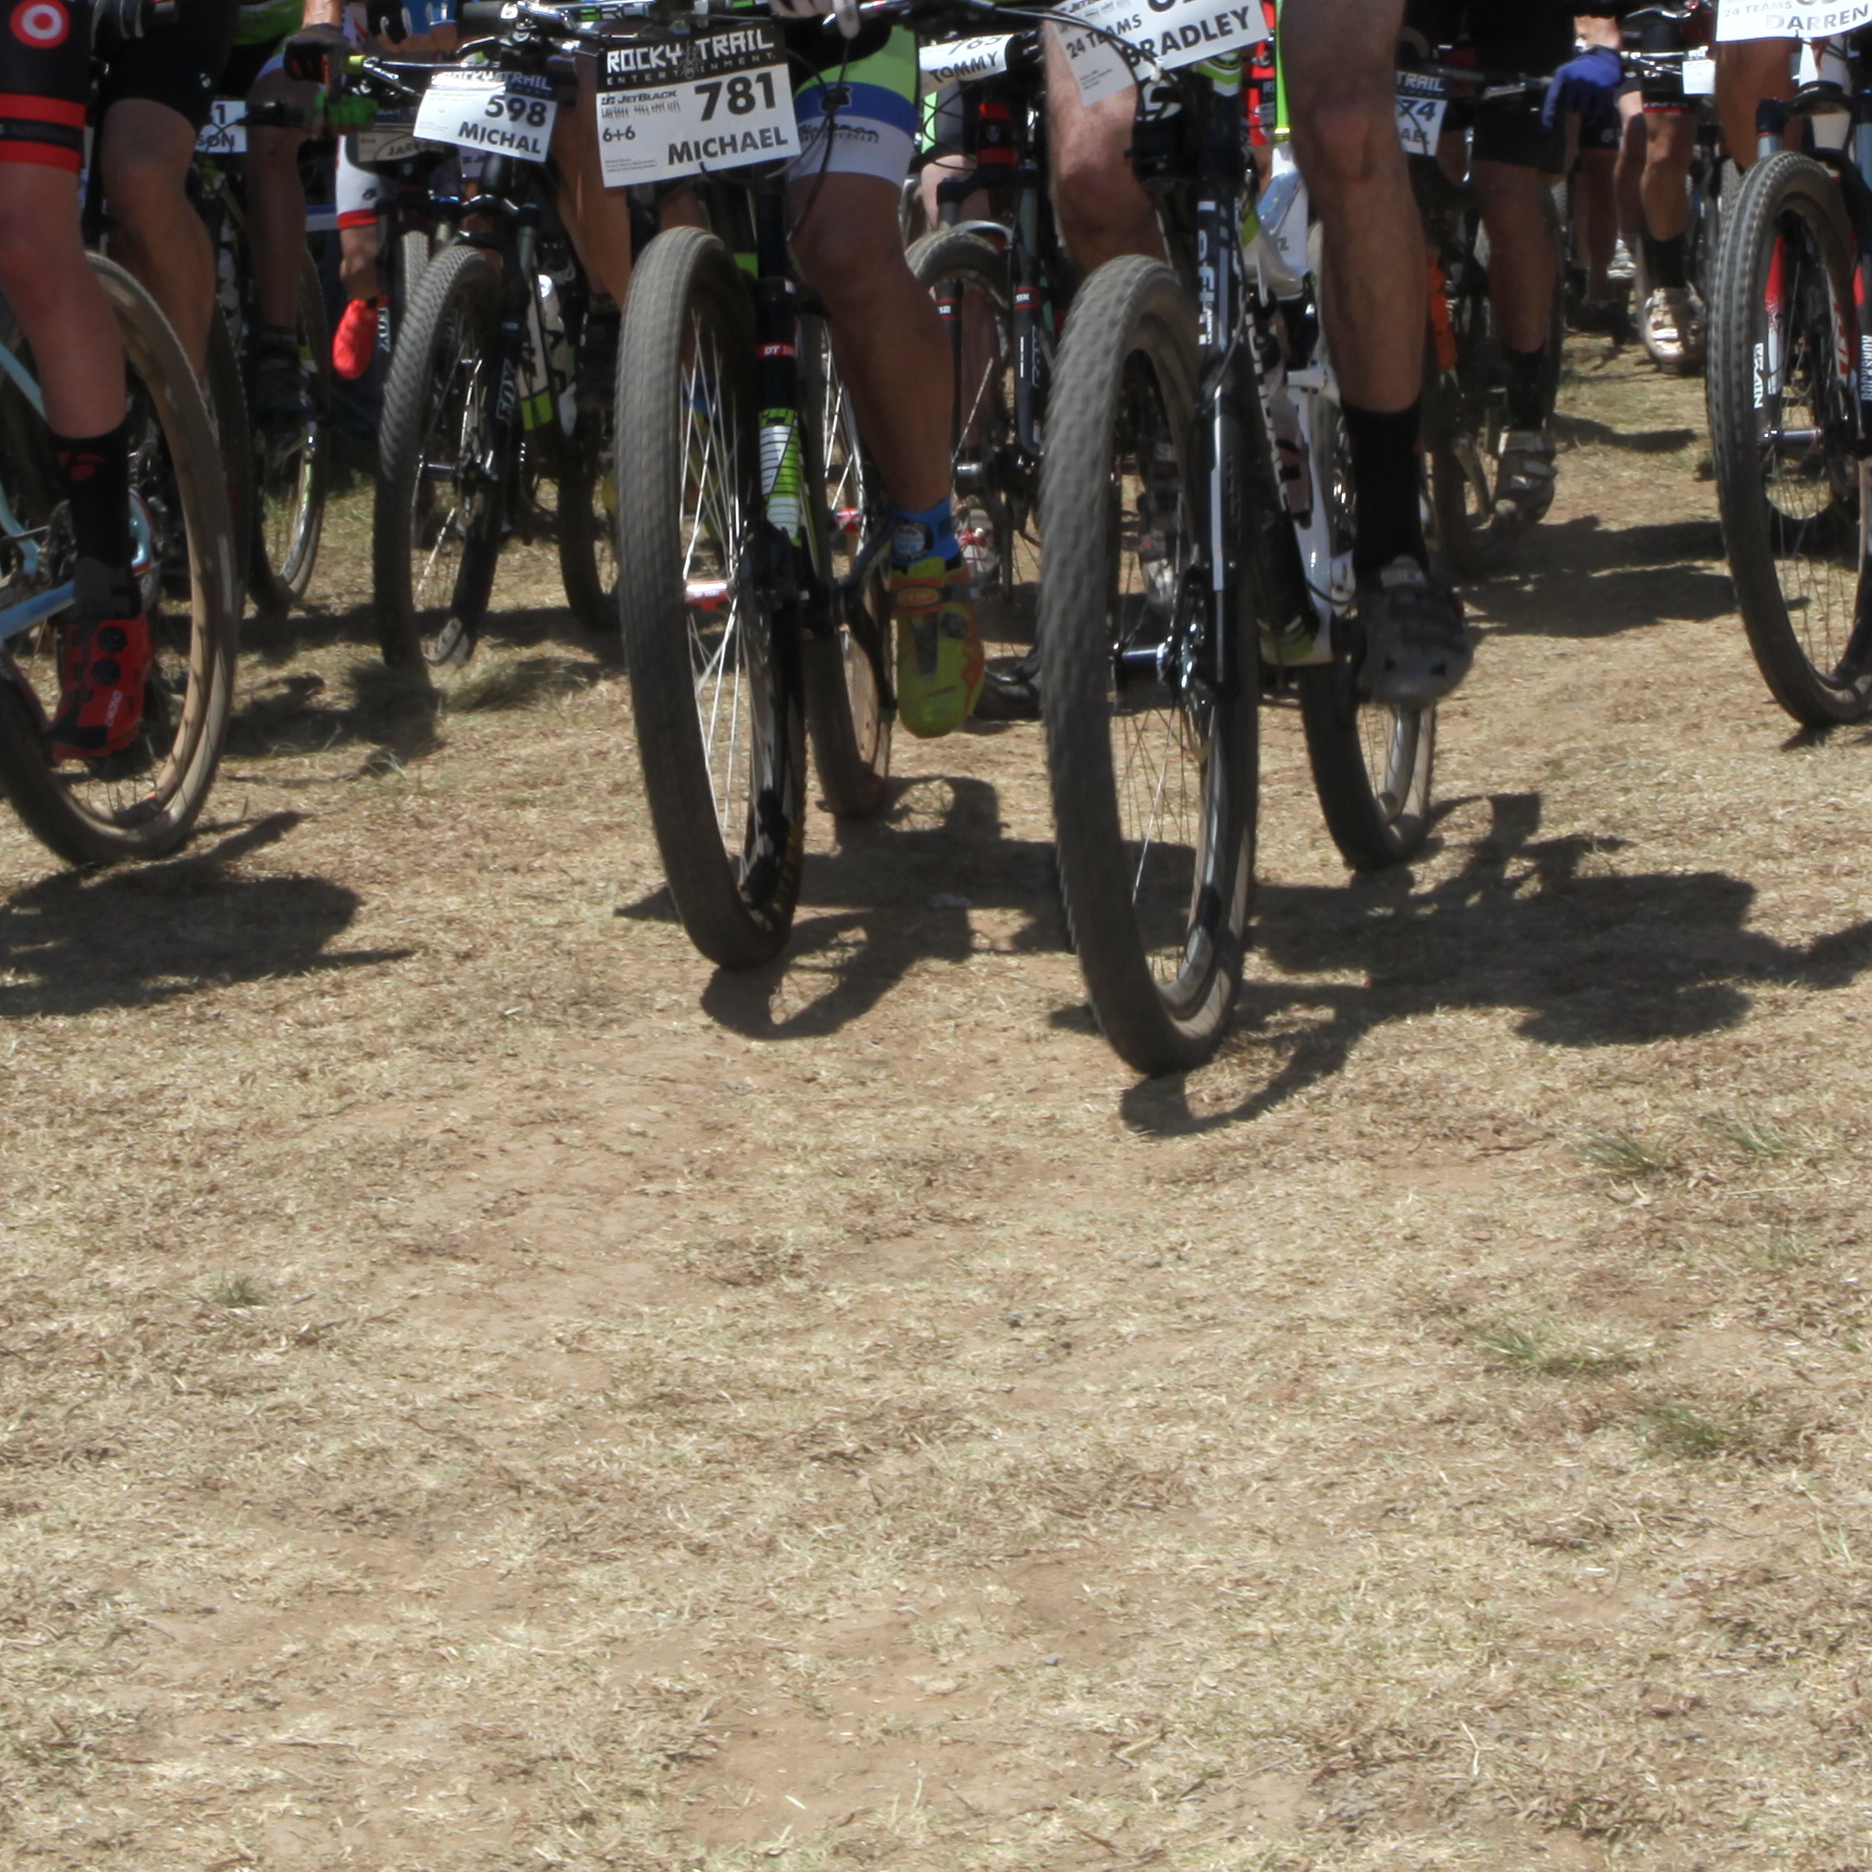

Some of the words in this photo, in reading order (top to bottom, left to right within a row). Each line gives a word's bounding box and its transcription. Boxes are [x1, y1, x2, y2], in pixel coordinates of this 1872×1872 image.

[1723, 8, 1740, 18] 24
[1744, 0, 1793, 14] TEAMS
[1765, 3, 1869, 31] DARREN
[606, 43, 683, 74] ROCKY
[694, 28, 776, 61] TRAIL
[1066, 36, 1087, 59] 24
[1088, 12, 1144, 49] TEAMS
[1126, 5, 1250, 68] BRADLEY
[928, 50, 1000, 84] TOMMY
[484, 94, 548, 127] 598
[617, 90, 678, 105] JETBLACK
[694, 71, 777, 123] 781
[458, 121, 542, 155] MICHAL
[602, 124, 636, 143] 6+6
[667, 125, 789, 166] MICHAEL
